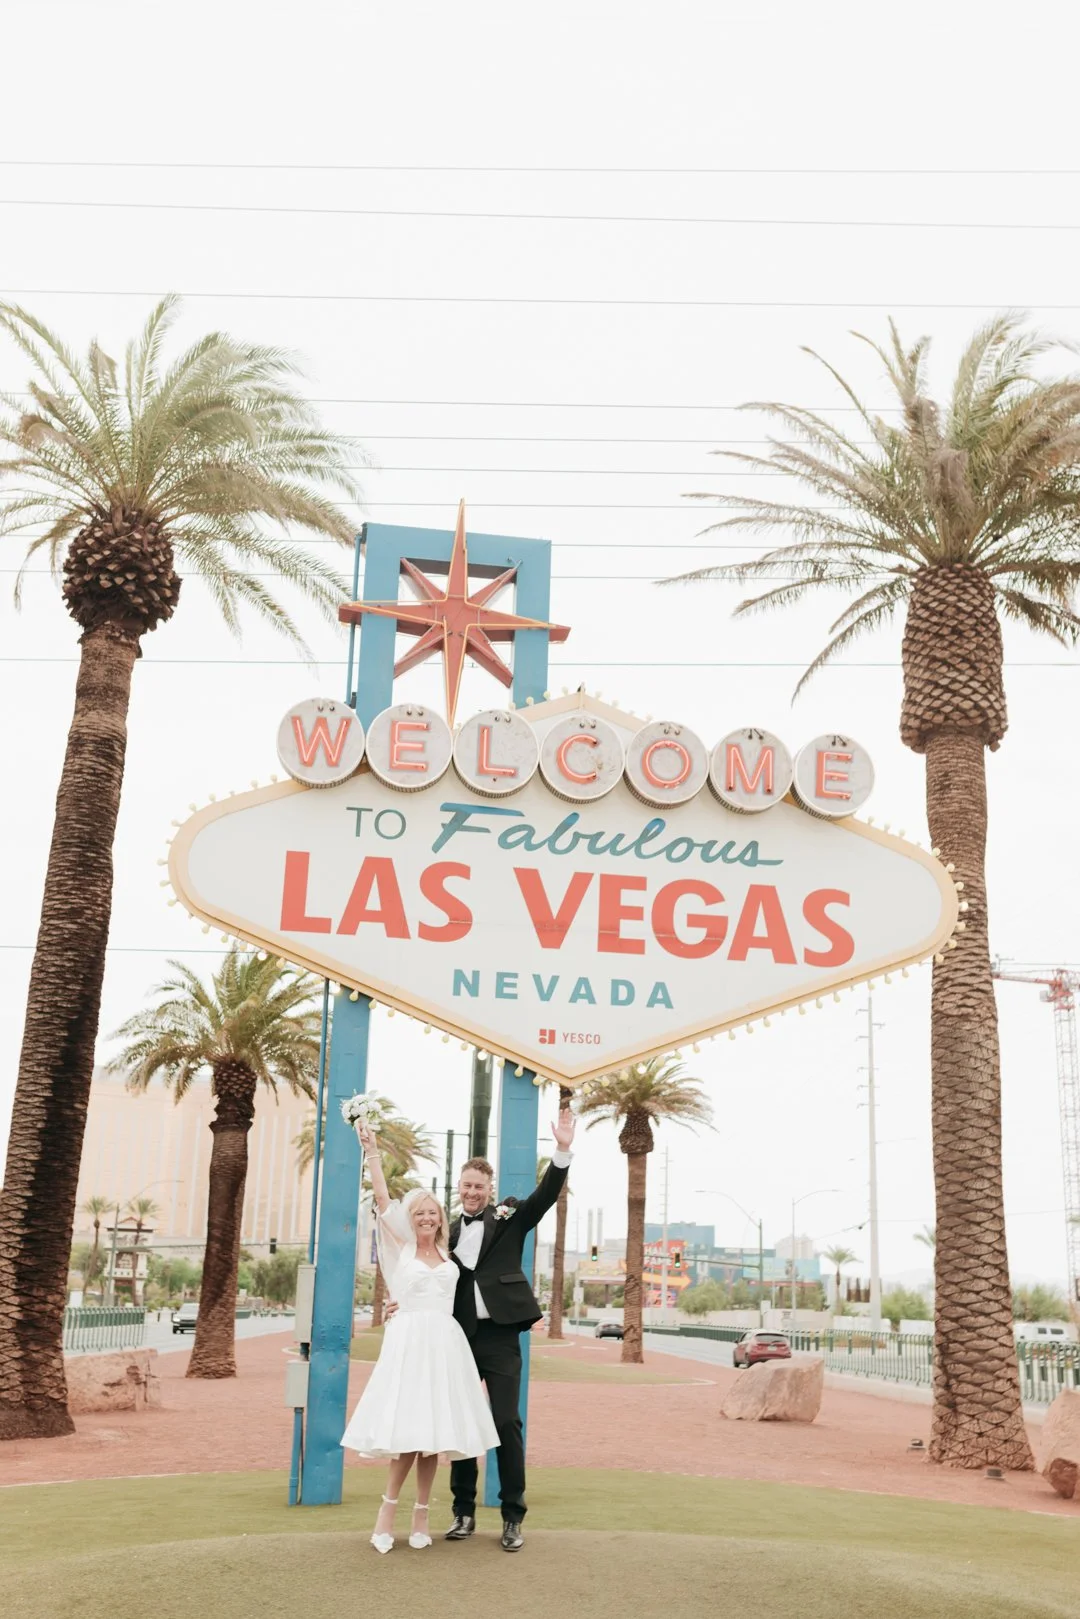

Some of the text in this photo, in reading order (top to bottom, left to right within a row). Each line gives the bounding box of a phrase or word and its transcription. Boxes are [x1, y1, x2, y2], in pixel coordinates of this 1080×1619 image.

[291, 716, 853, 800] WELCOME
[346, 802, 784, 867] TO Fabulous
[280, 850, 855, 968] LAS VEGAS
[452, 968, 674, 1010] NEVADA
[562, 1032, 601, 1045] YESCO
